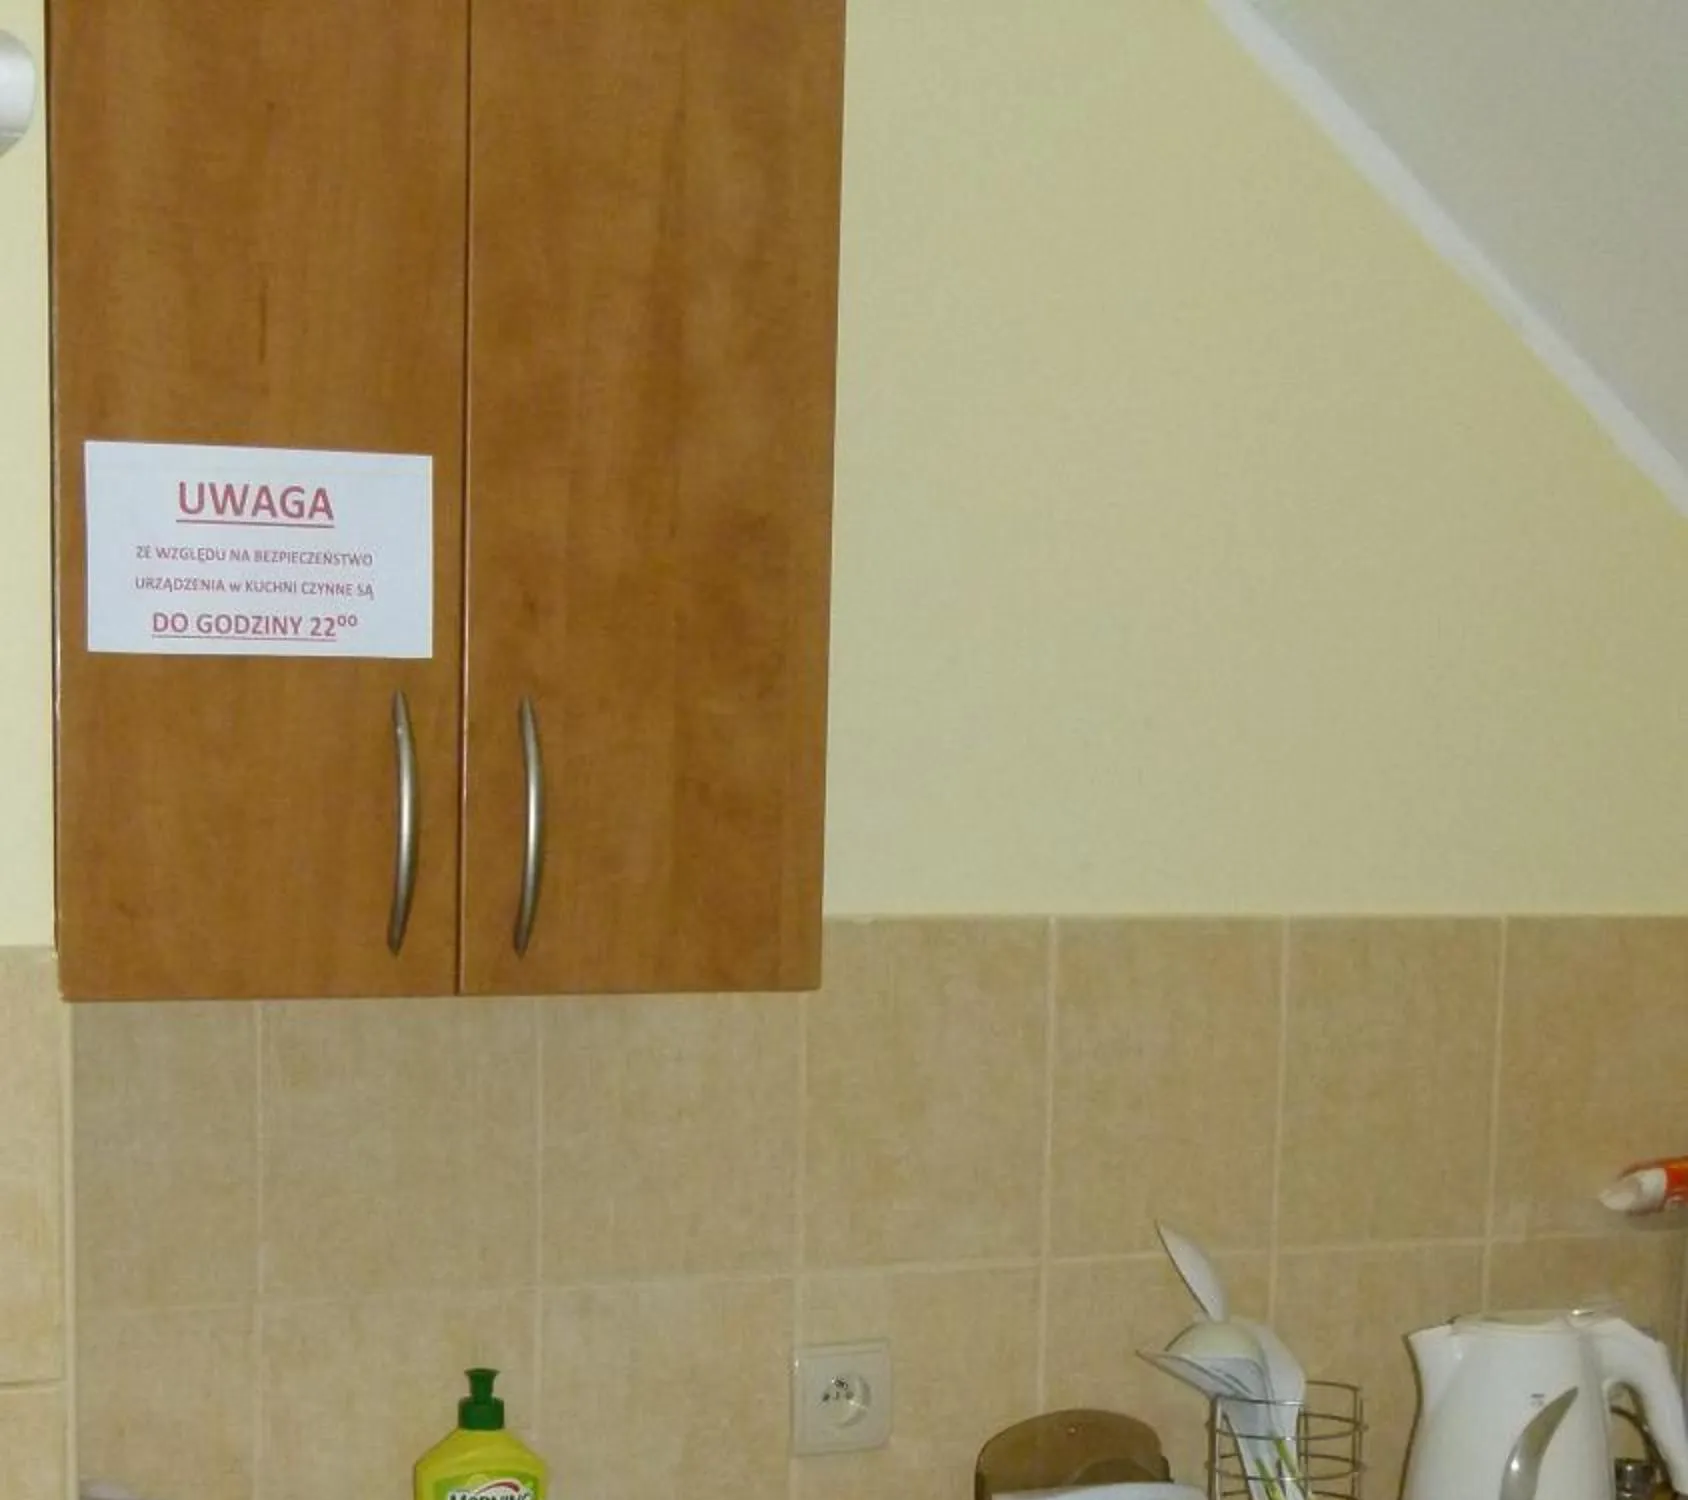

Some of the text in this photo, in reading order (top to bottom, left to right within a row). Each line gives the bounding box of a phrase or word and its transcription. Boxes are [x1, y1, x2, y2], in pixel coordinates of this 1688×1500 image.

[178, 481, 335, 520] UWAGA
[136, 546, 373, 567] ZE WZGLĘDU NA BEZPIECZEŃSTWO
[135, 577, 225, 592] URZĄDZENIA
[245, 579, 297, 593] KUCHNI
[301, 581, 353, 596] CZYNNE
[356, 583, 374, 600] SĄ
[153, 612, 189, 633] DO
[196, 614, 303, 635] GODZINY
